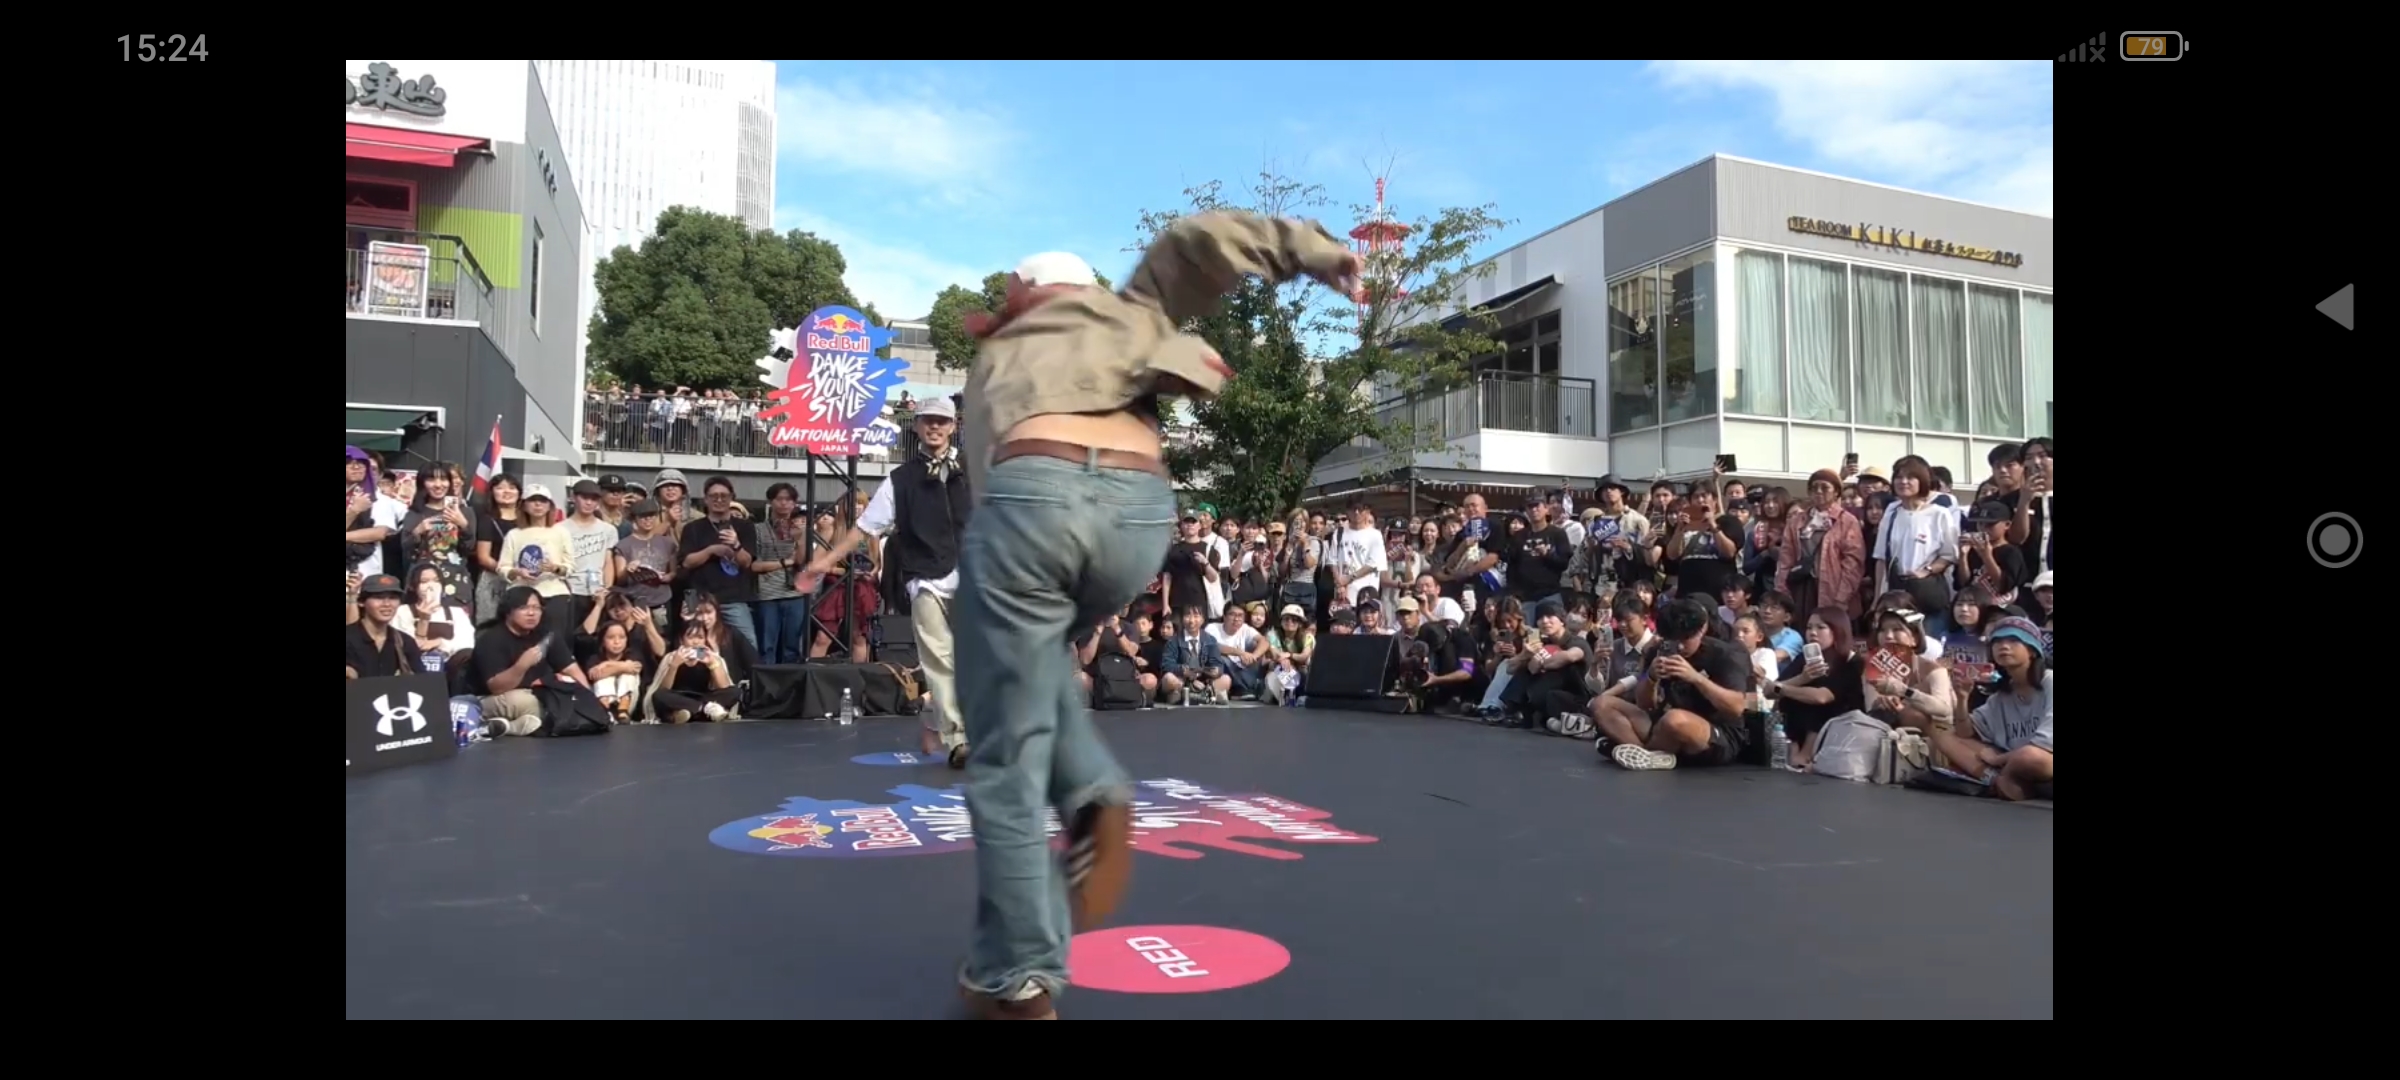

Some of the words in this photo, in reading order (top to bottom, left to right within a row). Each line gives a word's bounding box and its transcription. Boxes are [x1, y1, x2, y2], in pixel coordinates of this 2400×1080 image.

[346, 61, 447, 117] 東山
[1790, 215, 1816, 231] TEA
[1818, 219, 1852, 238] ROOM
[807, 332, 840, 350] Red
[840, 335, 871, 353] Bull
[807, 352, 869, 380] DANCE
[812, 370, 875, 400] YOUR
[808, 388, 868, 425] STYLE
[775, 426, 849, 443] NATIONAL
[850, 427, 894, 443] FINAL
[820, 444, 849, 453] JAPAN
[1876, 648, 1912, 677] RED
[376, 740, 402, 752] UNDER
[402, 736, 433, 748] ARMOUR
[841, 826, 923, 851] Red
[1126, 936, 1211, 979] RED
